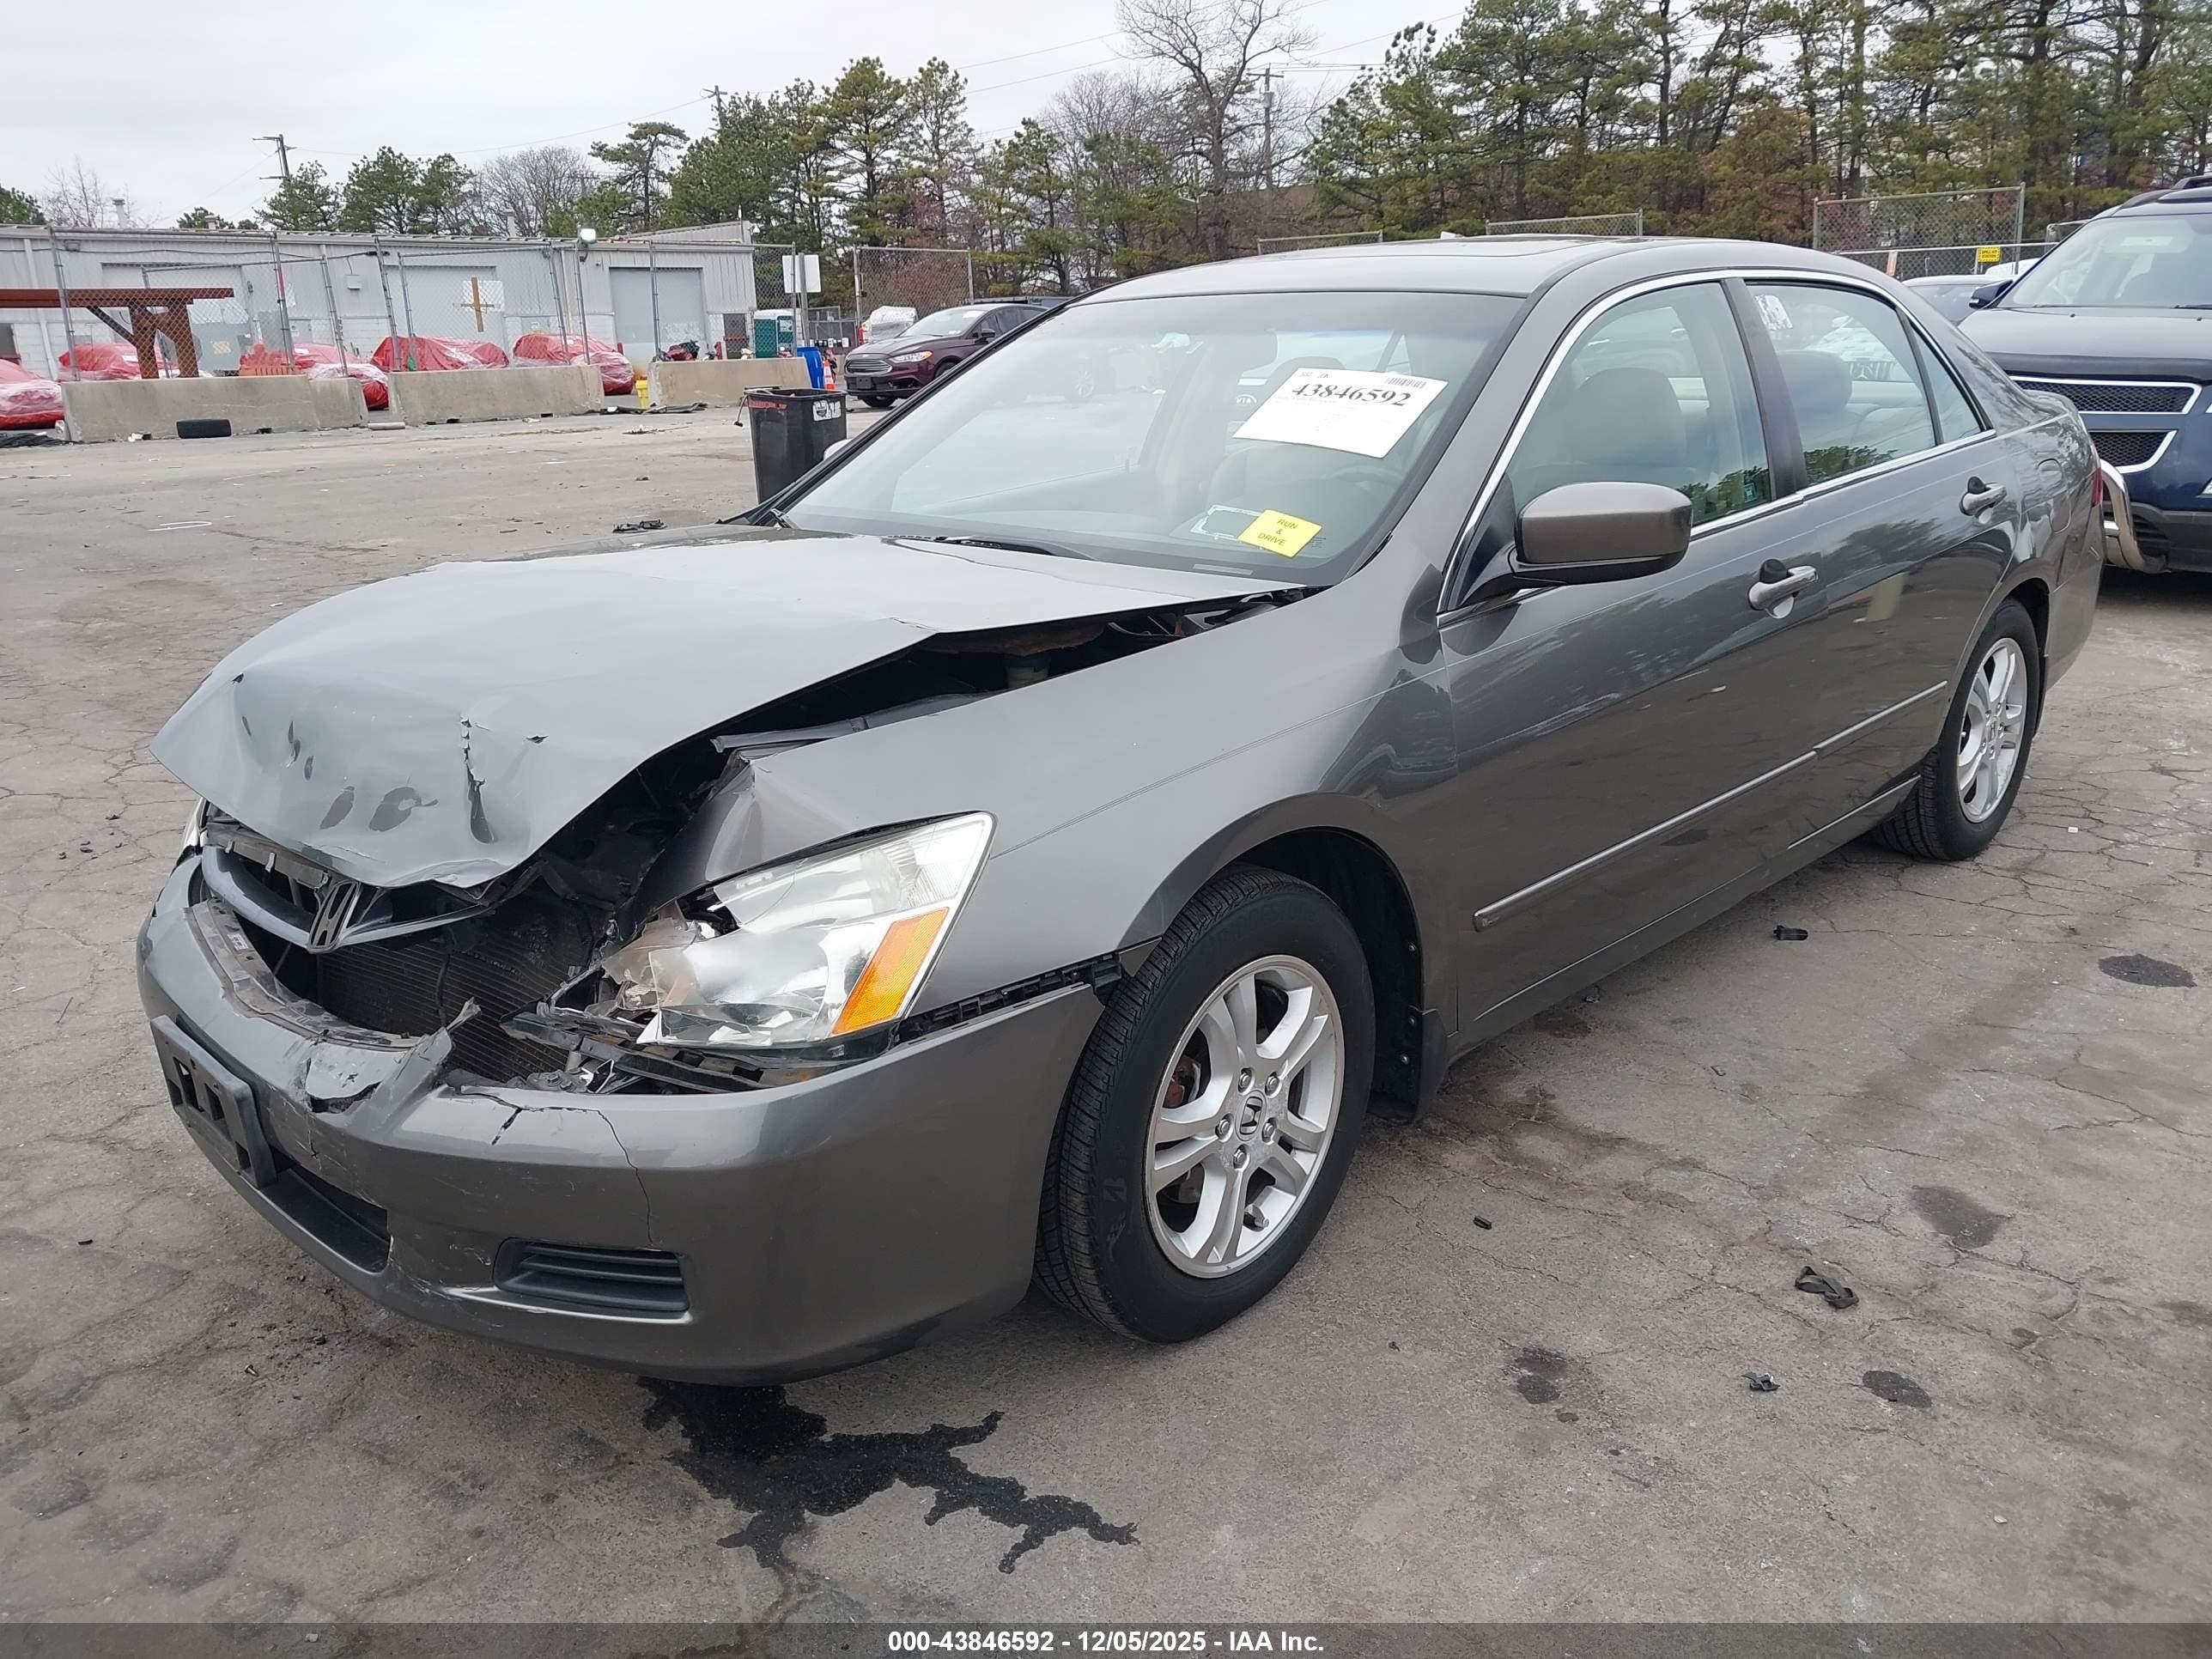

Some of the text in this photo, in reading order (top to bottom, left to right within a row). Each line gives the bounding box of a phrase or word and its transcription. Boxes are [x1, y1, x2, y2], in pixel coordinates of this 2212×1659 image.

[1292, 384, 1411, 406] 43846592
[1277, 519, 1298, 529] RUN
[1257, 532, 1286, 546] DRIVE
